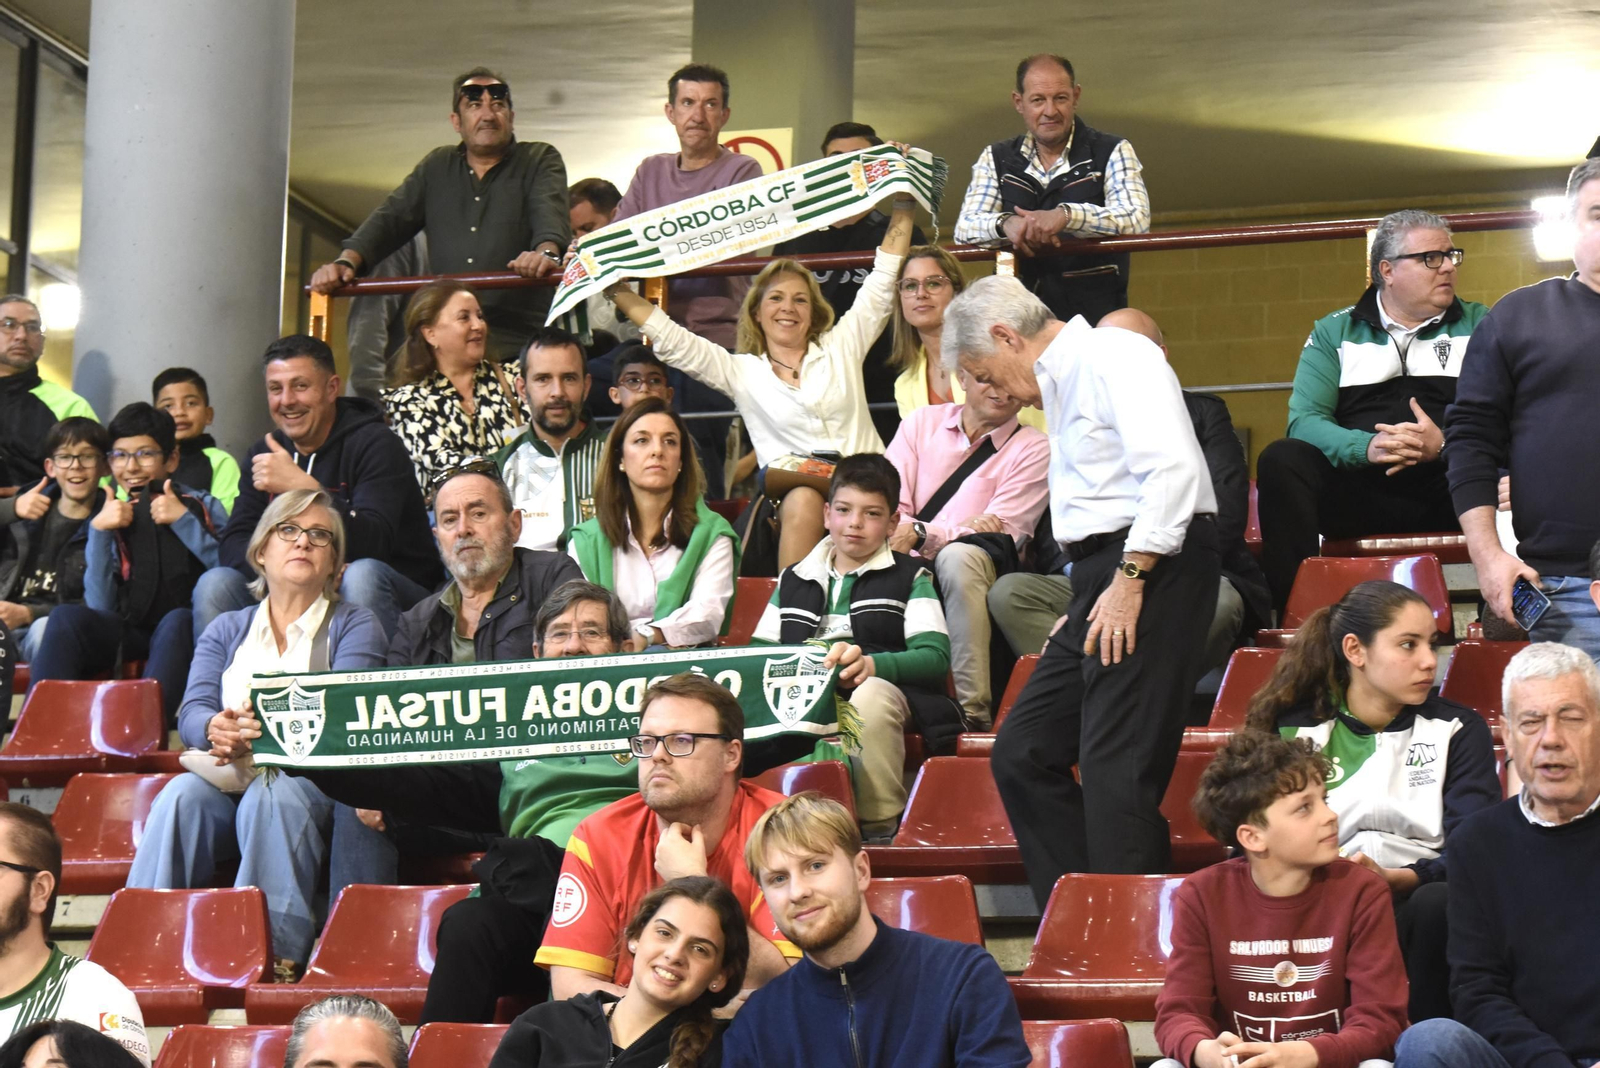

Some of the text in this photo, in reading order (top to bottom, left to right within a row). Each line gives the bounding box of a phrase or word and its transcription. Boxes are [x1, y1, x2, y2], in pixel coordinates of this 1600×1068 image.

[643, 194, 765, 242] CÓRDOBA
[767, 181, 796, 203] CF
[677, 225, 735, 255] DESDE
[738, 212, 778, 236] 1954
[62, 901, 71, 916] 7
[1229, 939, 1290, 956] SALVADOR
[1248, 988, 1317, 1003] BASKETBALL
